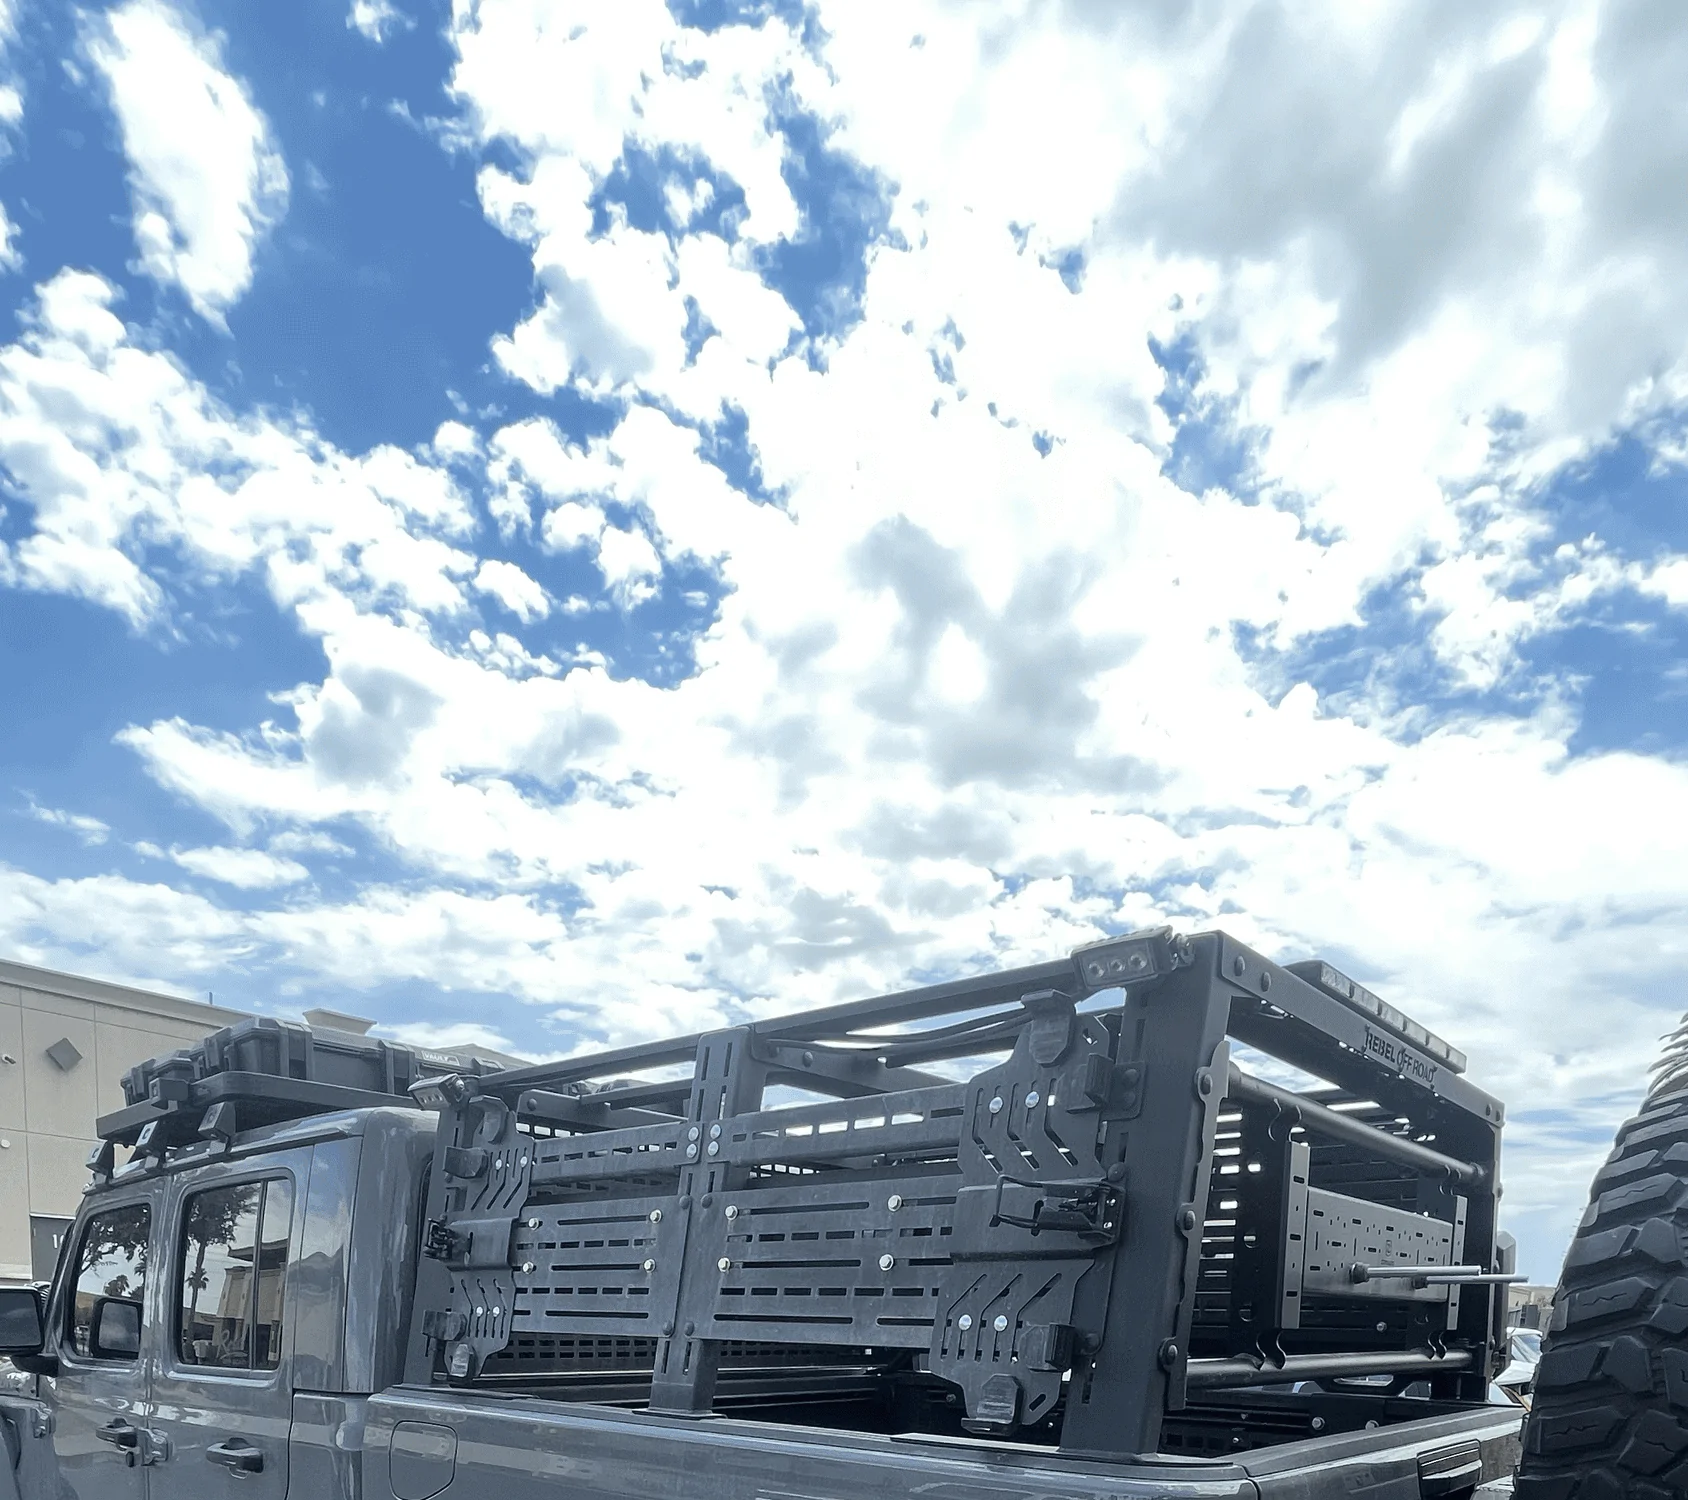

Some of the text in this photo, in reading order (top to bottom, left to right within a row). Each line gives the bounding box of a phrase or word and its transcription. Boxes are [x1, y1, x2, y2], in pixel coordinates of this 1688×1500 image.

[1362, 1026, 1437, 1083] REBEL OFF ROAD
